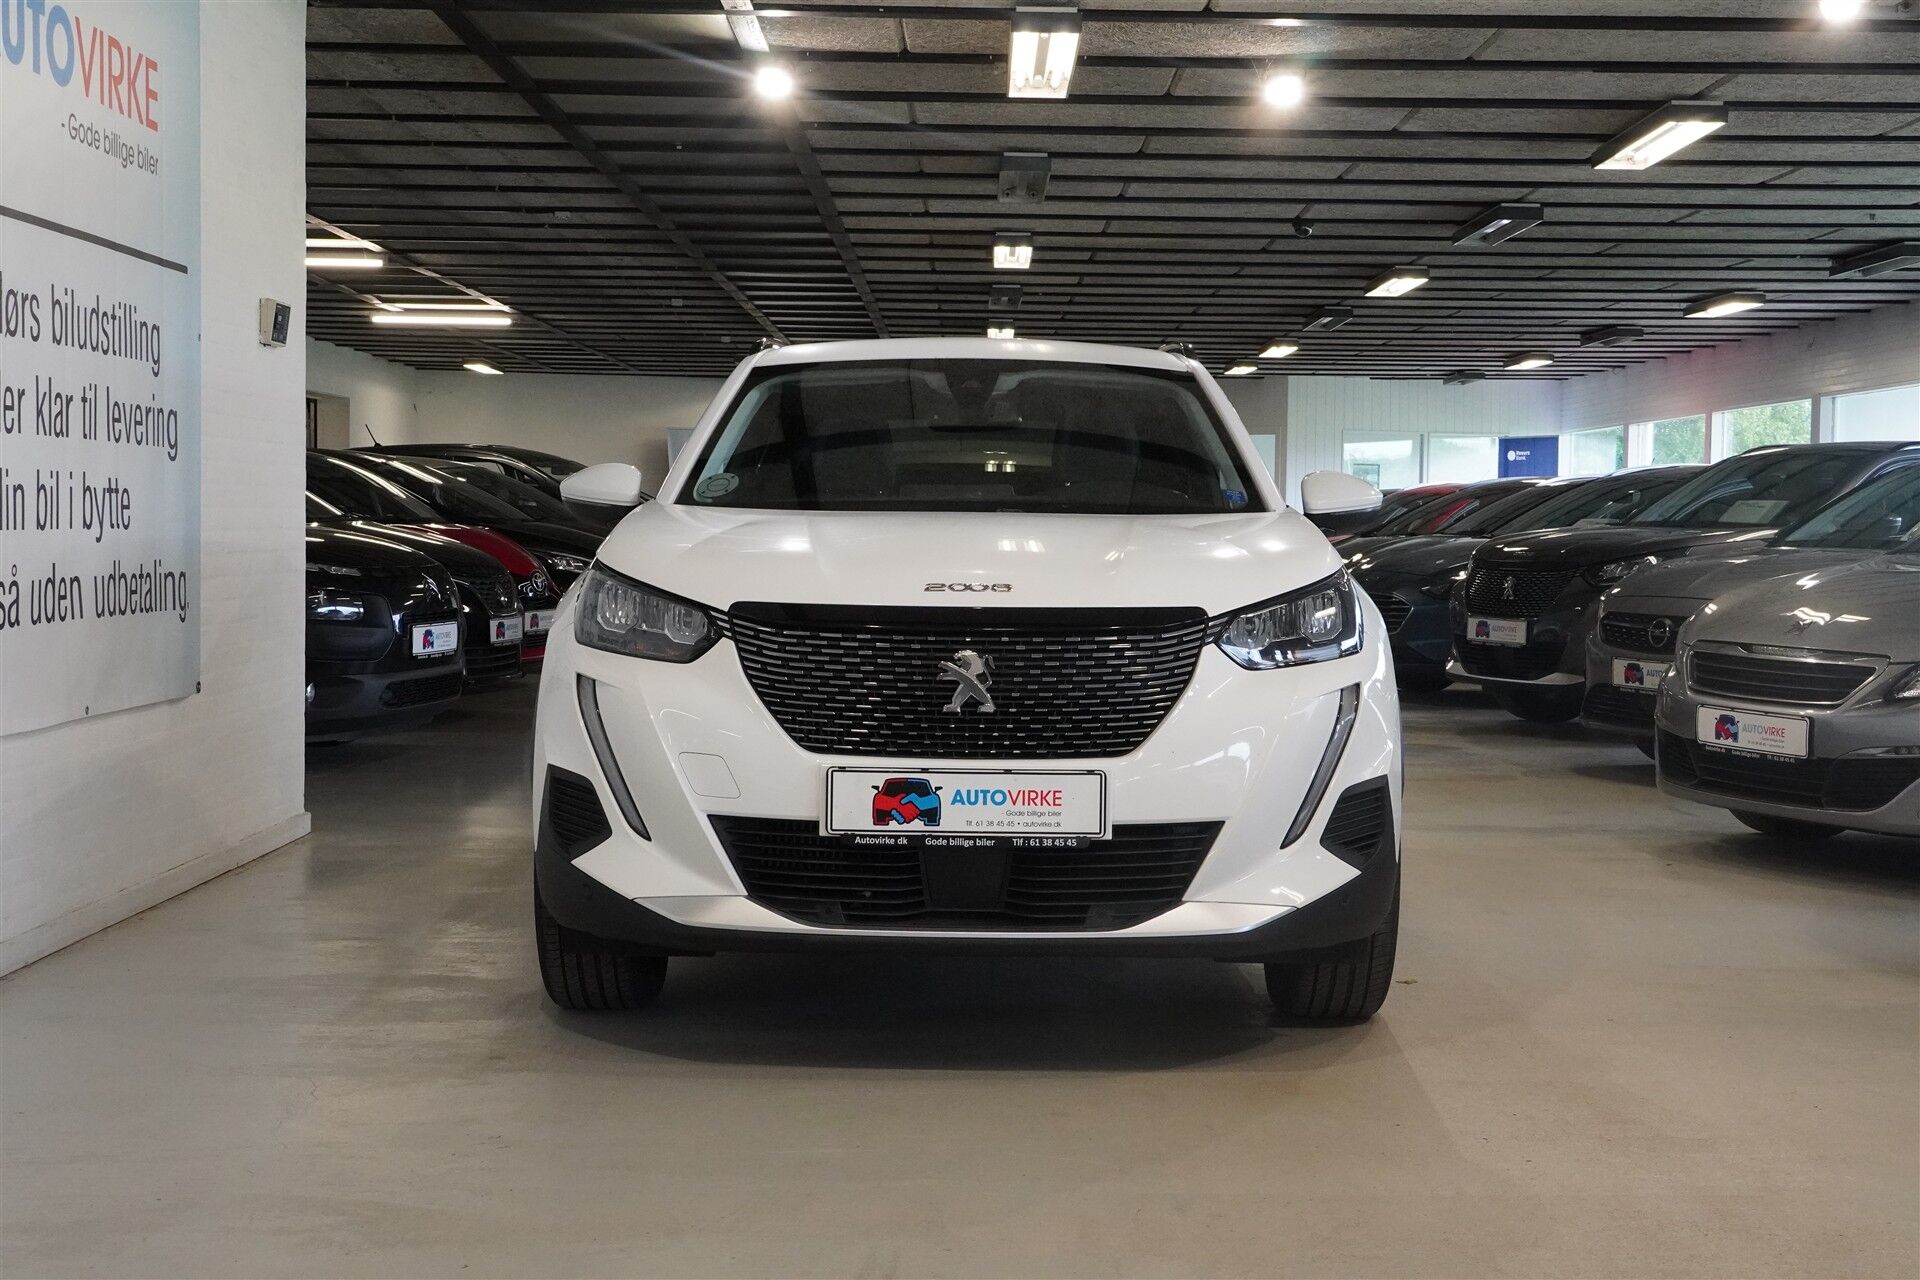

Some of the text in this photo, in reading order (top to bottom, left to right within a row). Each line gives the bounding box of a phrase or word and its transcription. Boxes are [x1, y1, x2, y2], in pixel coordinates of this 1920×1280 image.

[0, 0, 159, 132] UTOVIRKE
[68, 113, 101, 150] Gode
[103, 128, 135, 169] billige
[137, 144, 159, 176] biler
[0, 271, 161, 378] ørs biludstilling
[0, 374, 179, 462] er klar til levering
[0, 467, 131, 543] in bil i bytte
[30, 562, 83, 625] uden
[924, 582, 1014, 593] 2008
[1742, 723, 1786, 738] AUTOVIRKE
[950, 788, 1062, 807] AUTOVIRKE
[1006, 809, 1025, 817] Gode
[1026, 810, 1047, 819] billige
[1047, 810, 1062, 818] biler
[854, 836, 895, 845] Autovirke
[897, 836, 908, 845] dk
[925, 837, 948, 846] Gode
[949, 838, 974, 848] billige
[976, 838, 995, 846] biler
[1012, 838, 1024, 846] Tlf
[1029, 838, 1040, 846] 61
[1042, 838, 1053, 847] 38
[1054, 838, 1065, 847] 45
[1066, 838, 1077, 847] 45
[975, 820, 984, 828] 61
[986, 820, 995, 828] 38
[996, 820, 1005, 828] 45
[1006, 820, 1016, 828] 45
